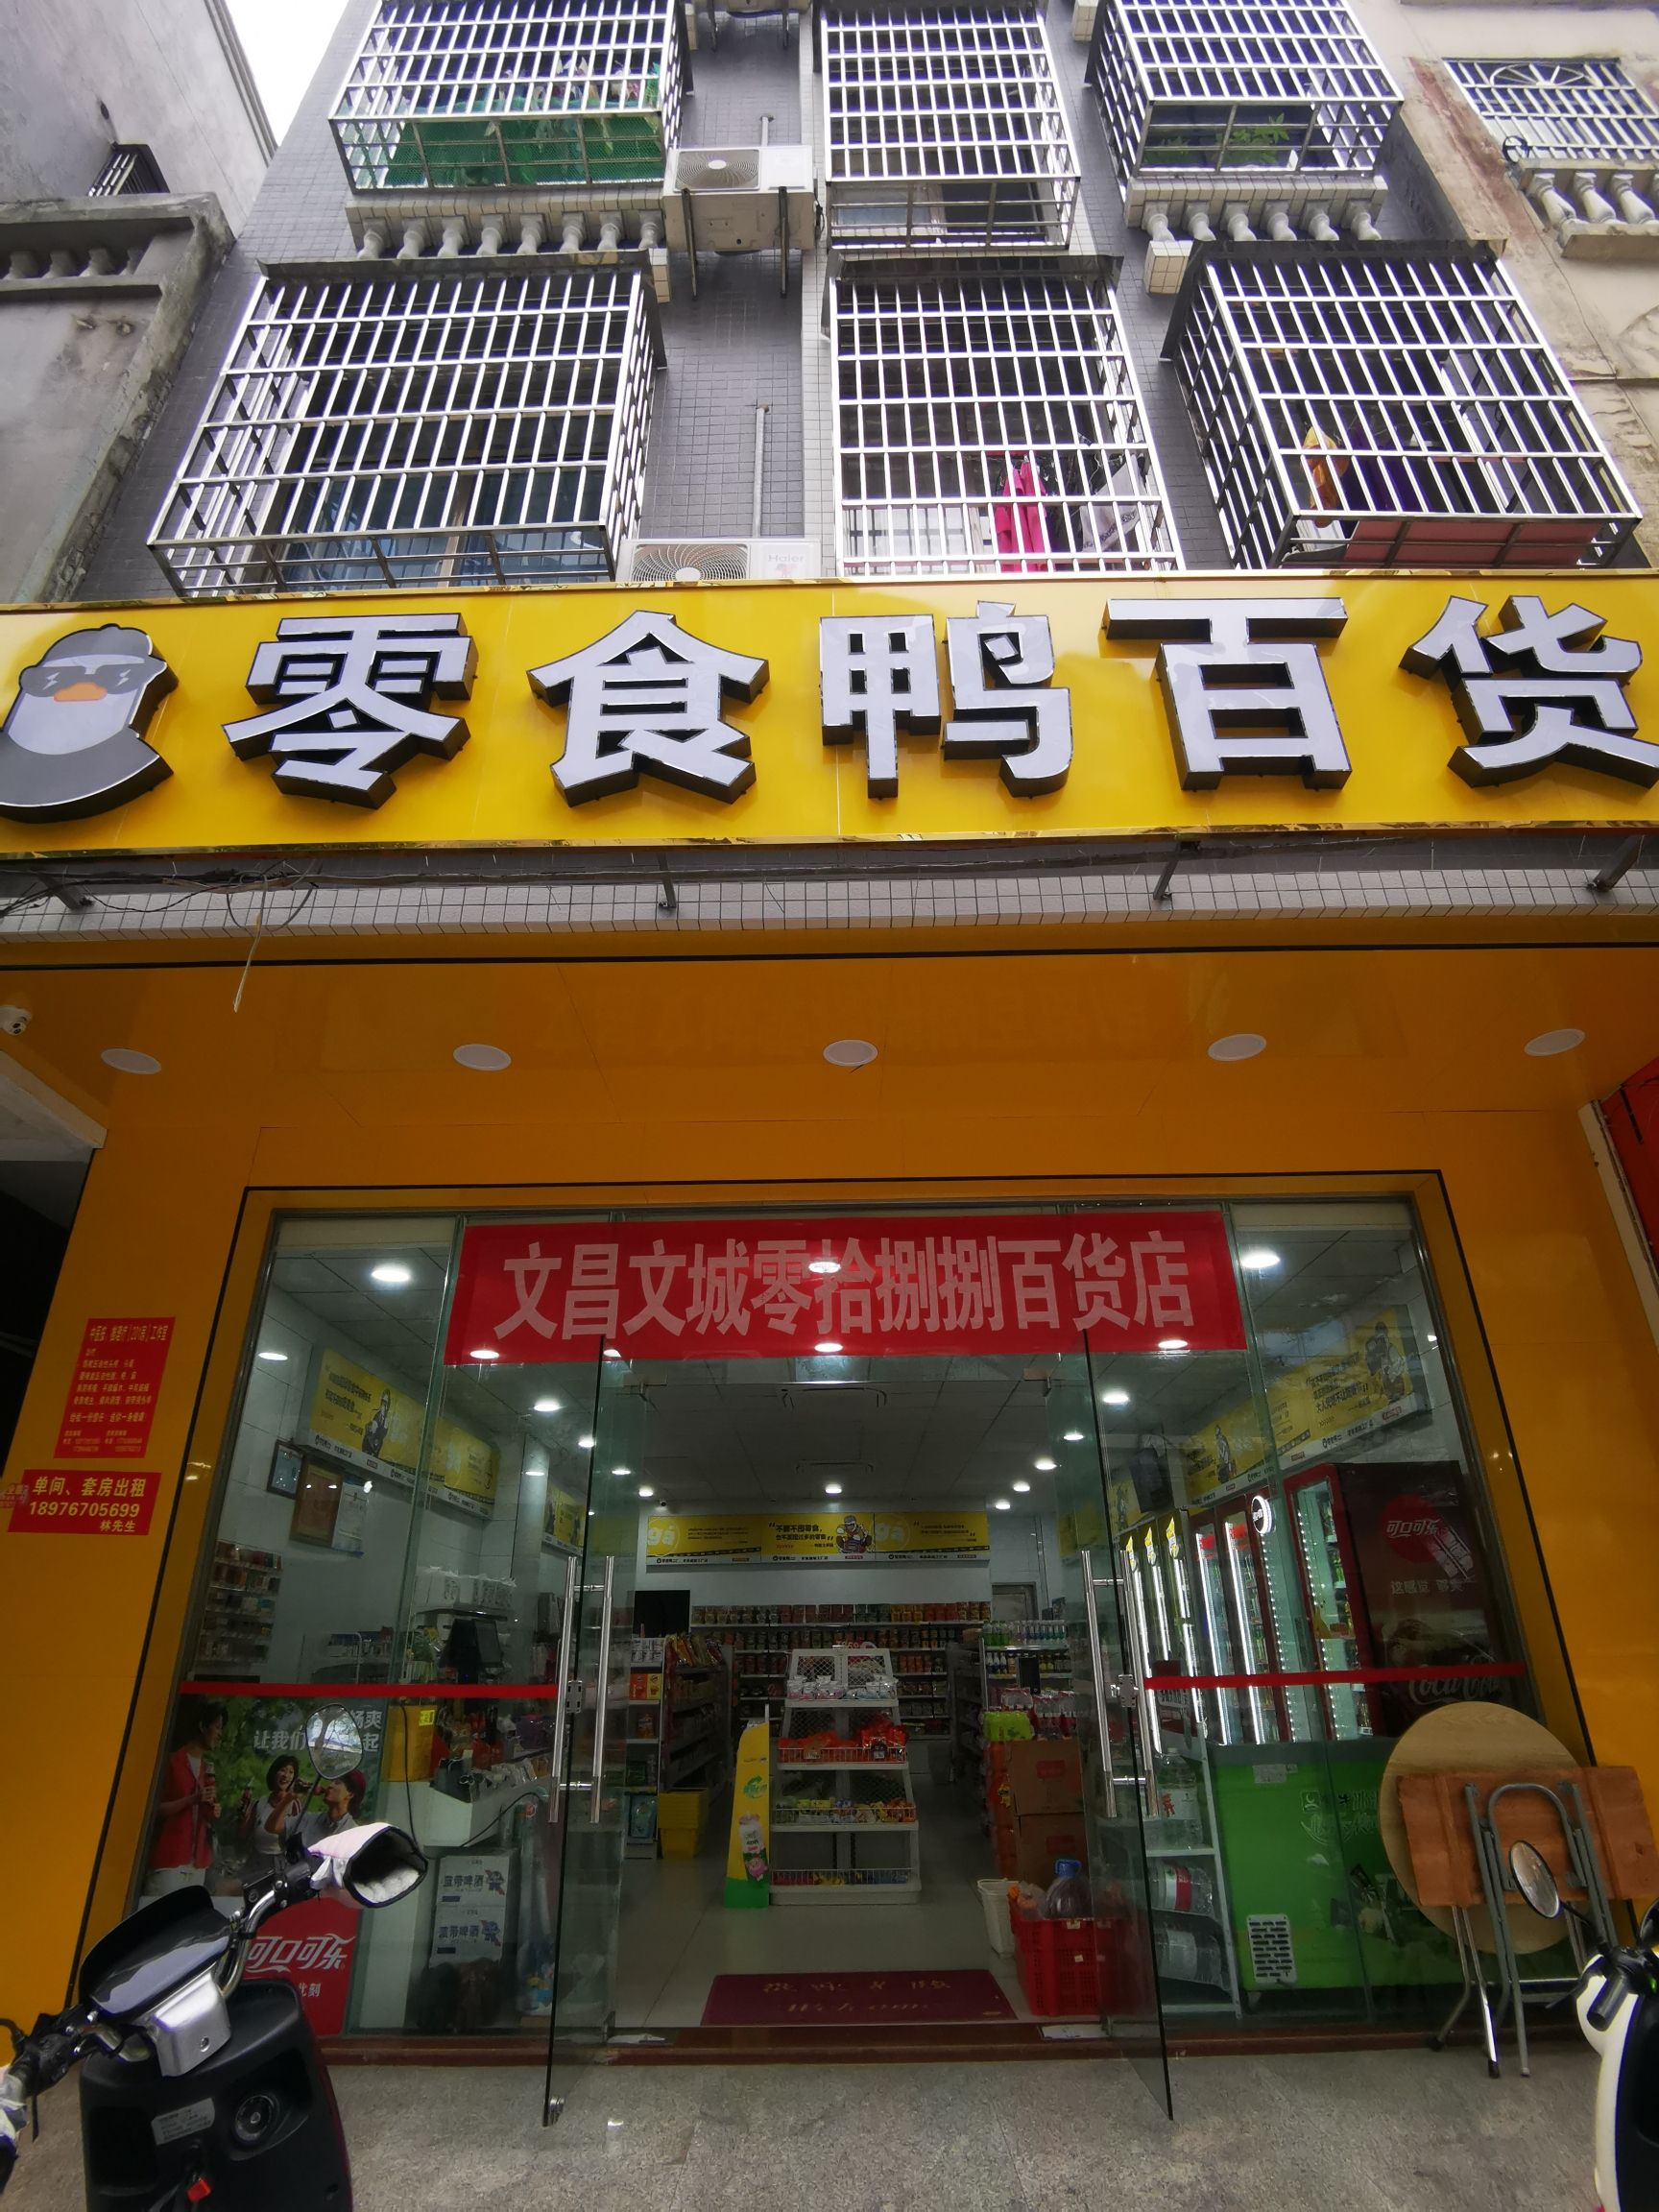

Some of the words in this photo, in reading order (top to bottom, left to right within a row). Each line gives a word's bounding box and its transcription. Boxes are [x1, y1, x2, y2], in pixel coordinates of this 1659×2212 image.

[223, 594, 1659, 809] 零食鸭百货
[493, 1231, 1193, 1339] 文昌文城零拾捌捌百货店
[33, 1476, 147, 1498] 单间、套房出租
[30, 1502, 140, 1517] 18976705699
[99, 1520, 136, 1532] 林先生
[246, 1933, 356, 1973] 可口可乐
